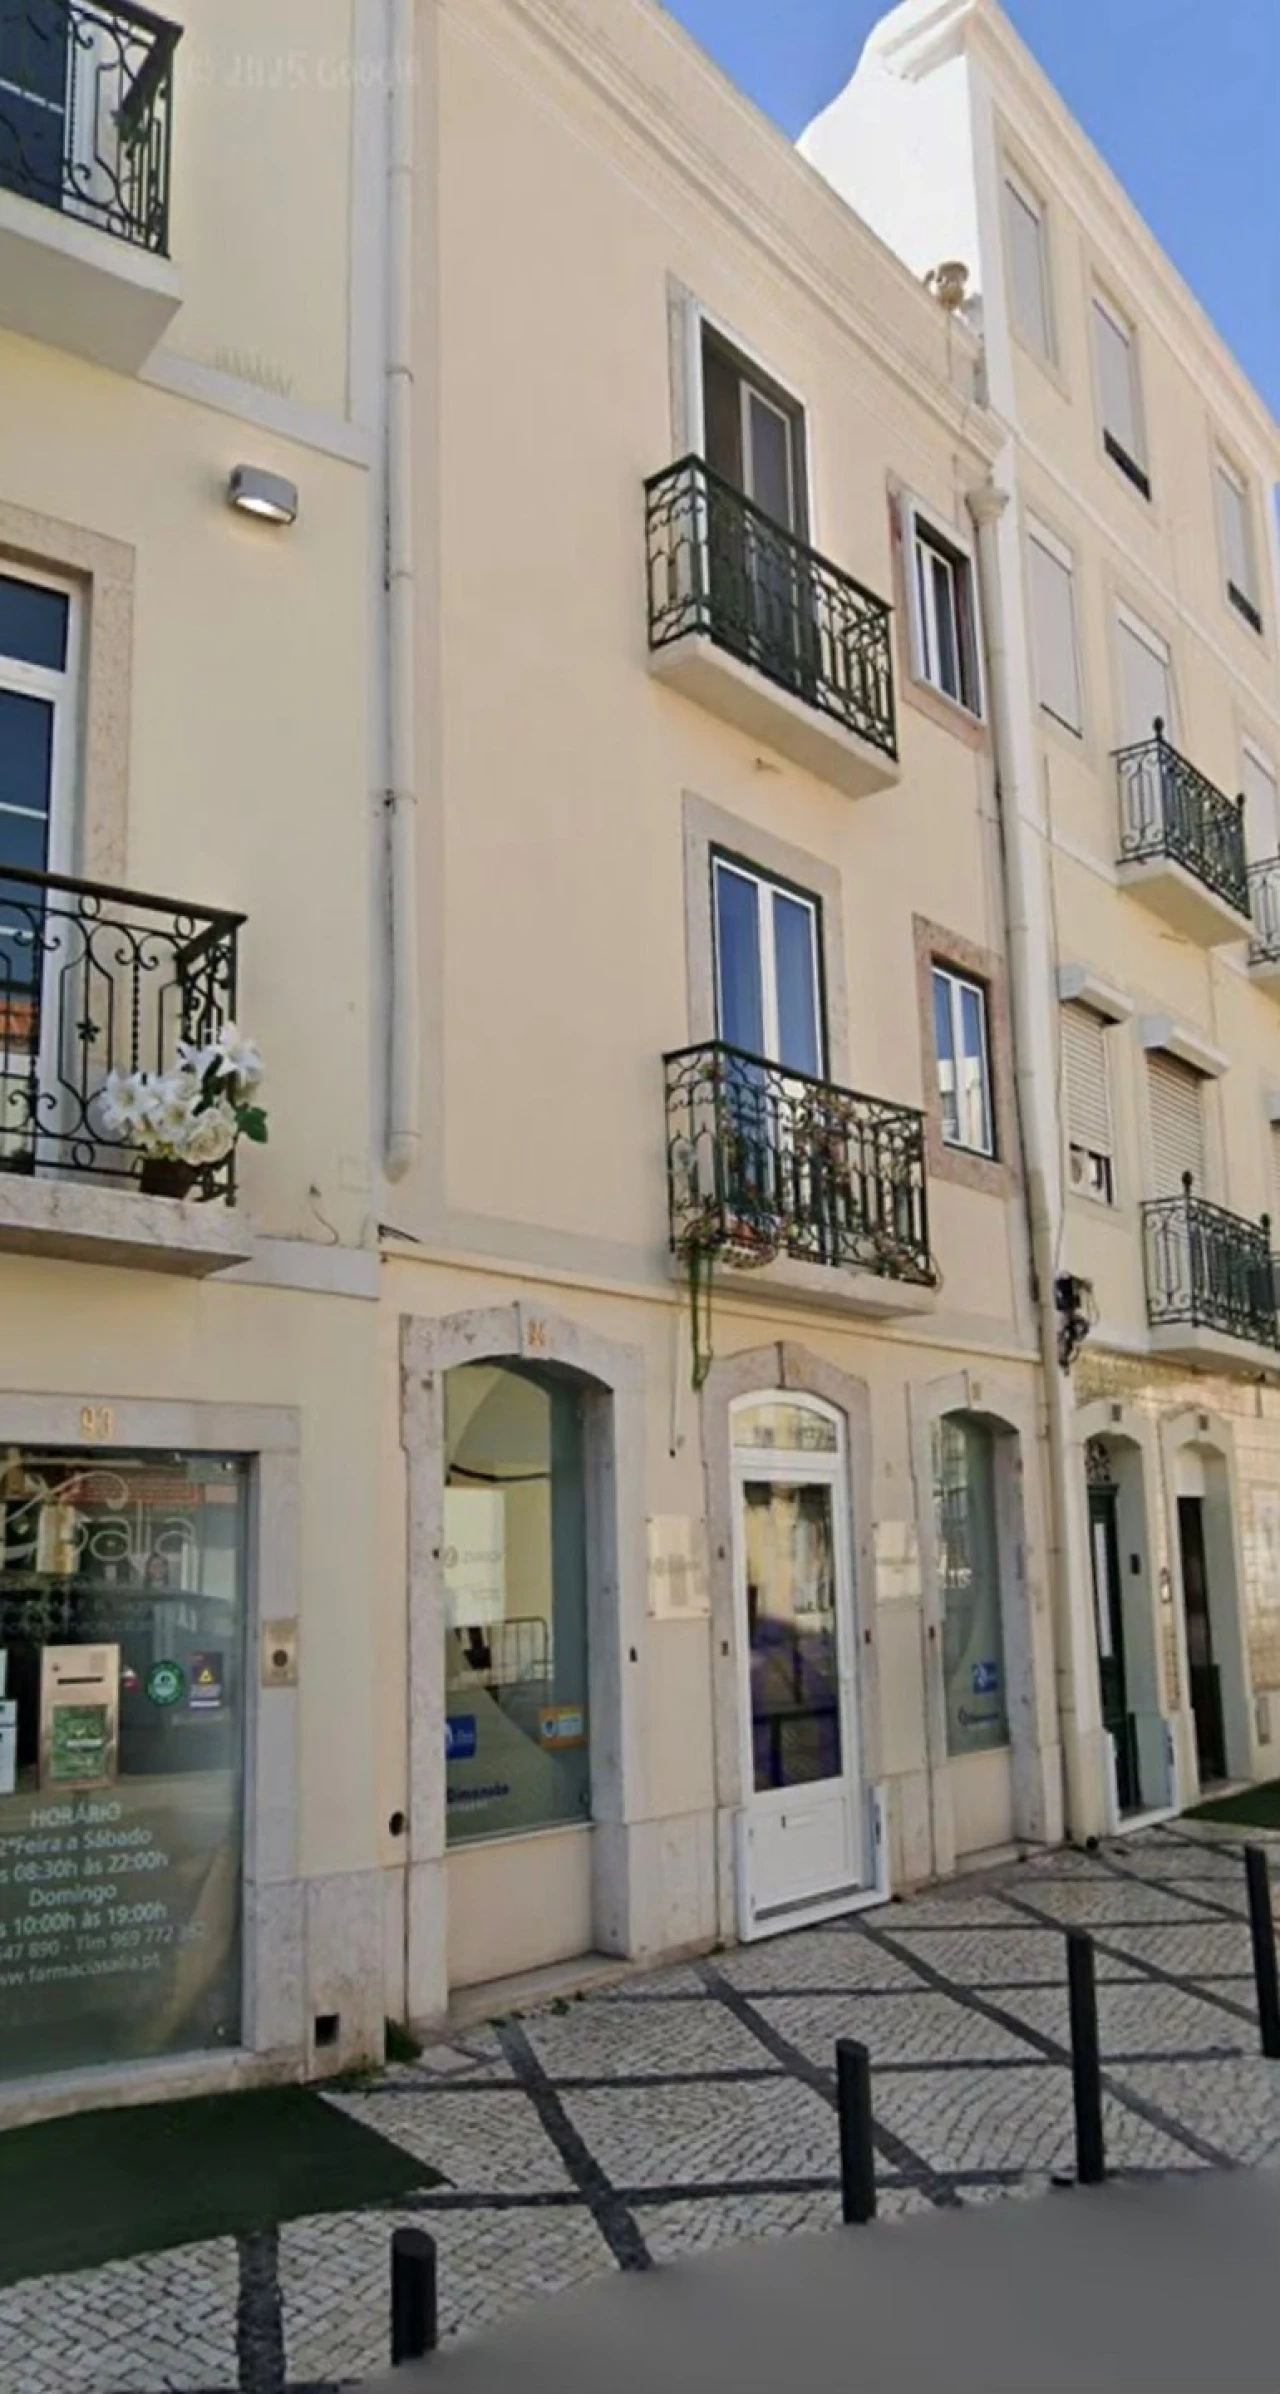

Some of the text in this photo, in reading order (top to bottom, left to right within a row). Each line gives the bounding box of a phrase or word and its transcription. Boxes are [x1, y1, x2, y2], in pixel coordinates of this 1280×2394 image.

[30, 1802, 120, 1828] HORÁRIO
[66, 1836, 79, 1850] a
[83, 1826, 153, 1849] Sábado
[14, 1858, 78, 1881] 08:30h
[106, 1850, 169, 1873] 22:00h
[28, 1883, 117, 1908] Domingo
[13, 1911, 76, 1936] 10:00h
[106, 1899, 168, 1924] 19:00h
